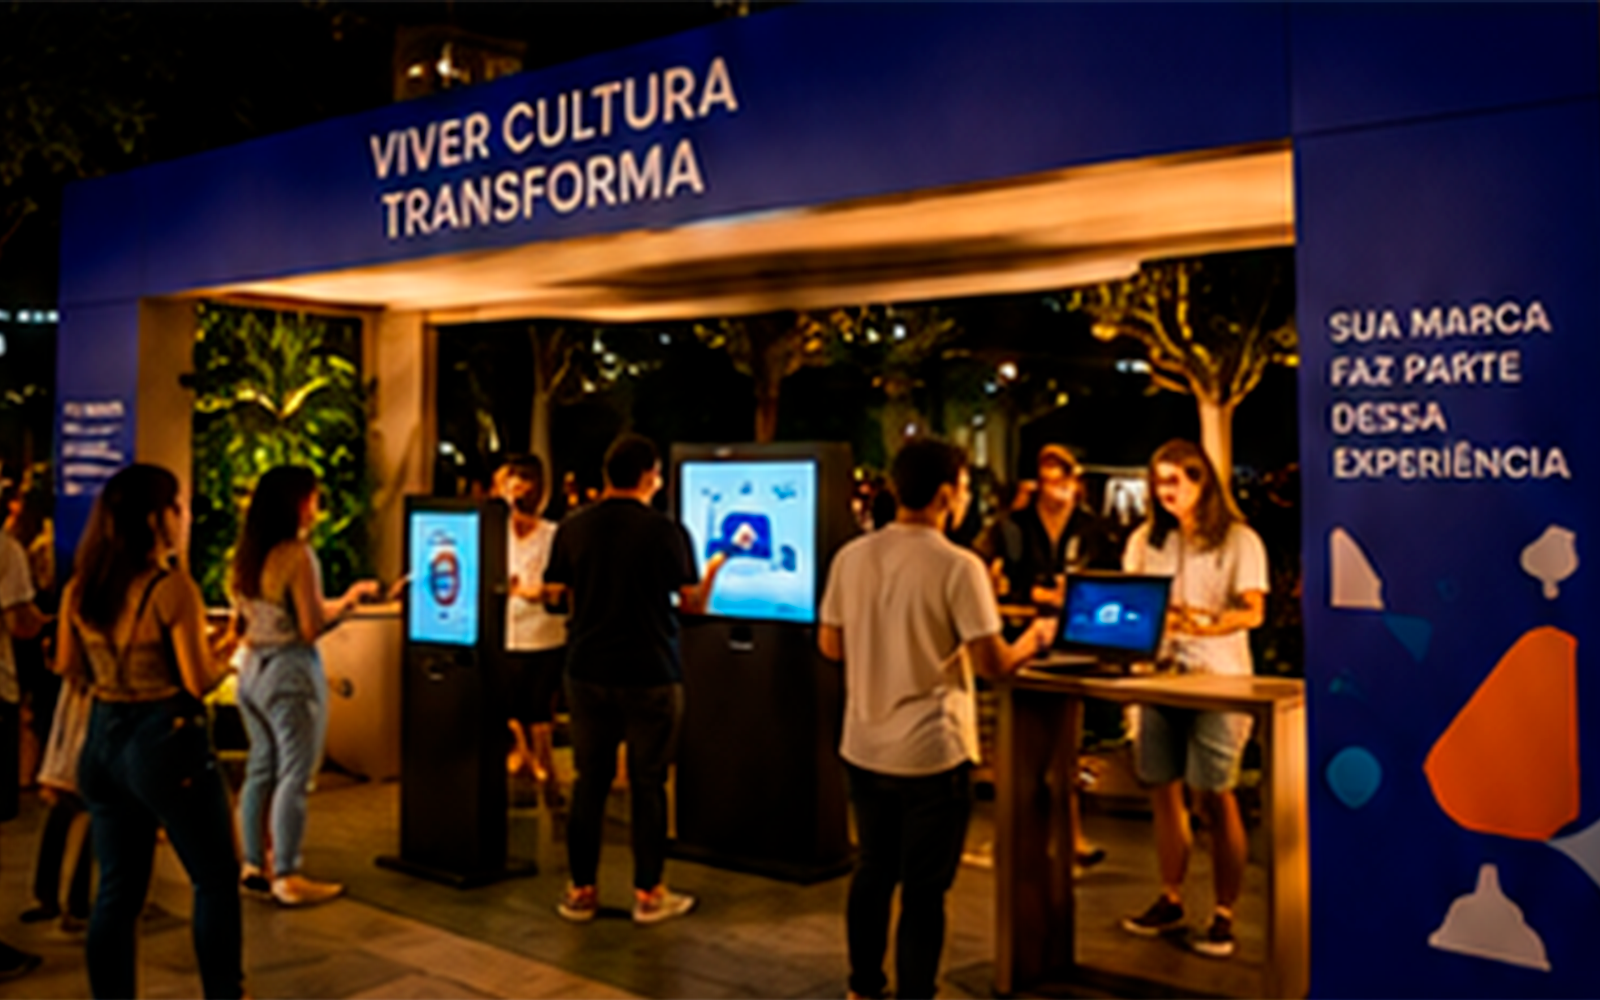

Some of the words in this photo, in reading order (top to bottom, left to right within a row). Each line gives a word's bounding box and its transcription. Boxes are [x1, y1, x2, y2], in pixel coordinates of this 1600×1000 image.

[370, 112, 491, 180] VIVER
[502, 56, 739, 154] CULTURA
[382, 138, 704, 240] TRANSFORMA
[1330, 311, 1400, 343] SUA
[1409, 301, 1552, 339] MARCA
[1331, 355, 1394, 387] FAZ
[1404, 350, 1522, 385] PARTE
[1332, 402, 1448, 434] DESSA
